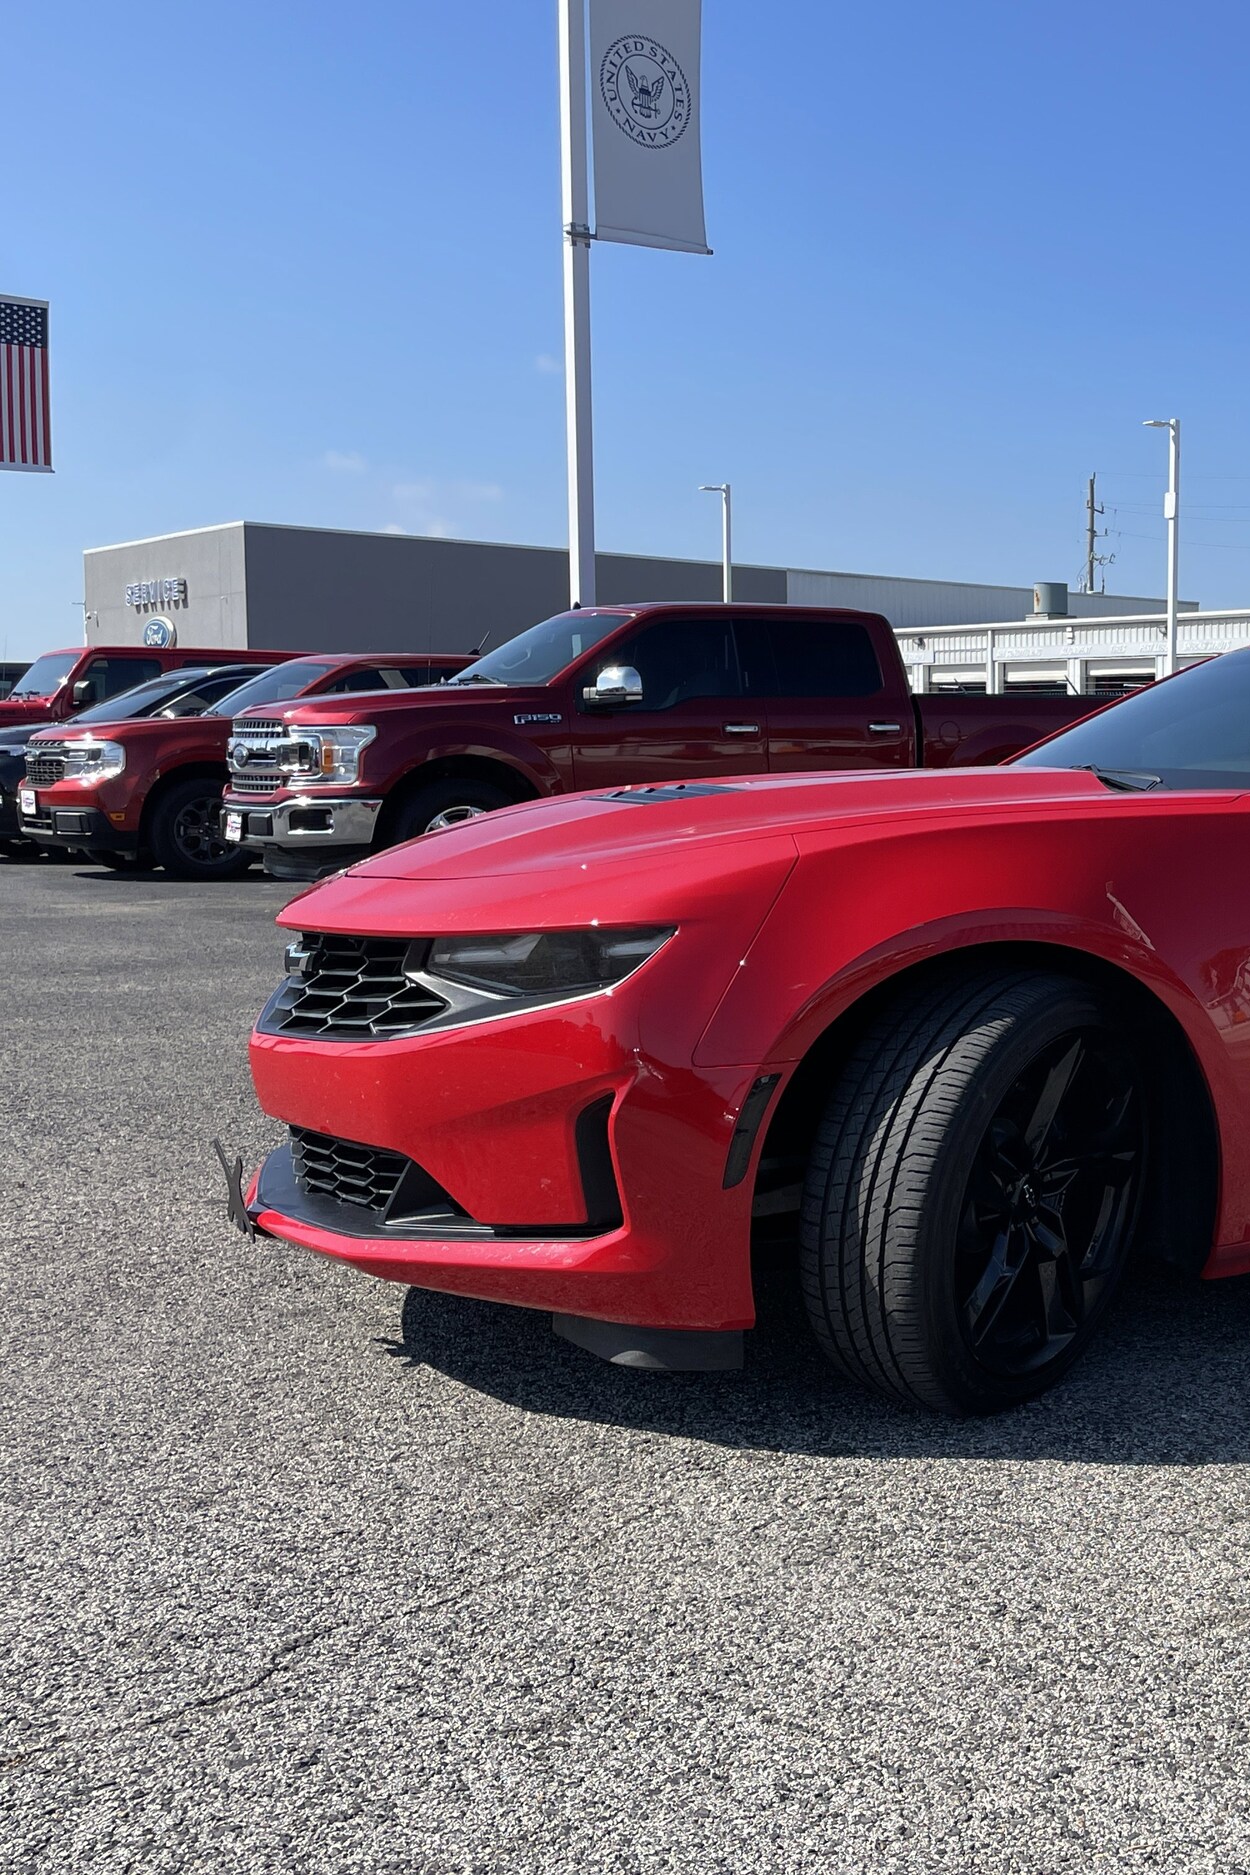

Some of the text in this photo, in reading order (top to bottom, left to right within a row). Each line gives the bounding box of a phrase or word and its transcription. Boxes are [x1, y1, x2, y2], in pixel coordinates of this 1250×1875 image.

[606, 40, 684, 122] UNITED STATES
[622, 117, 671, 143] NAVY
[126, 577, 180, 607] SERVICE
[146, 624, 164, 646] Ford
